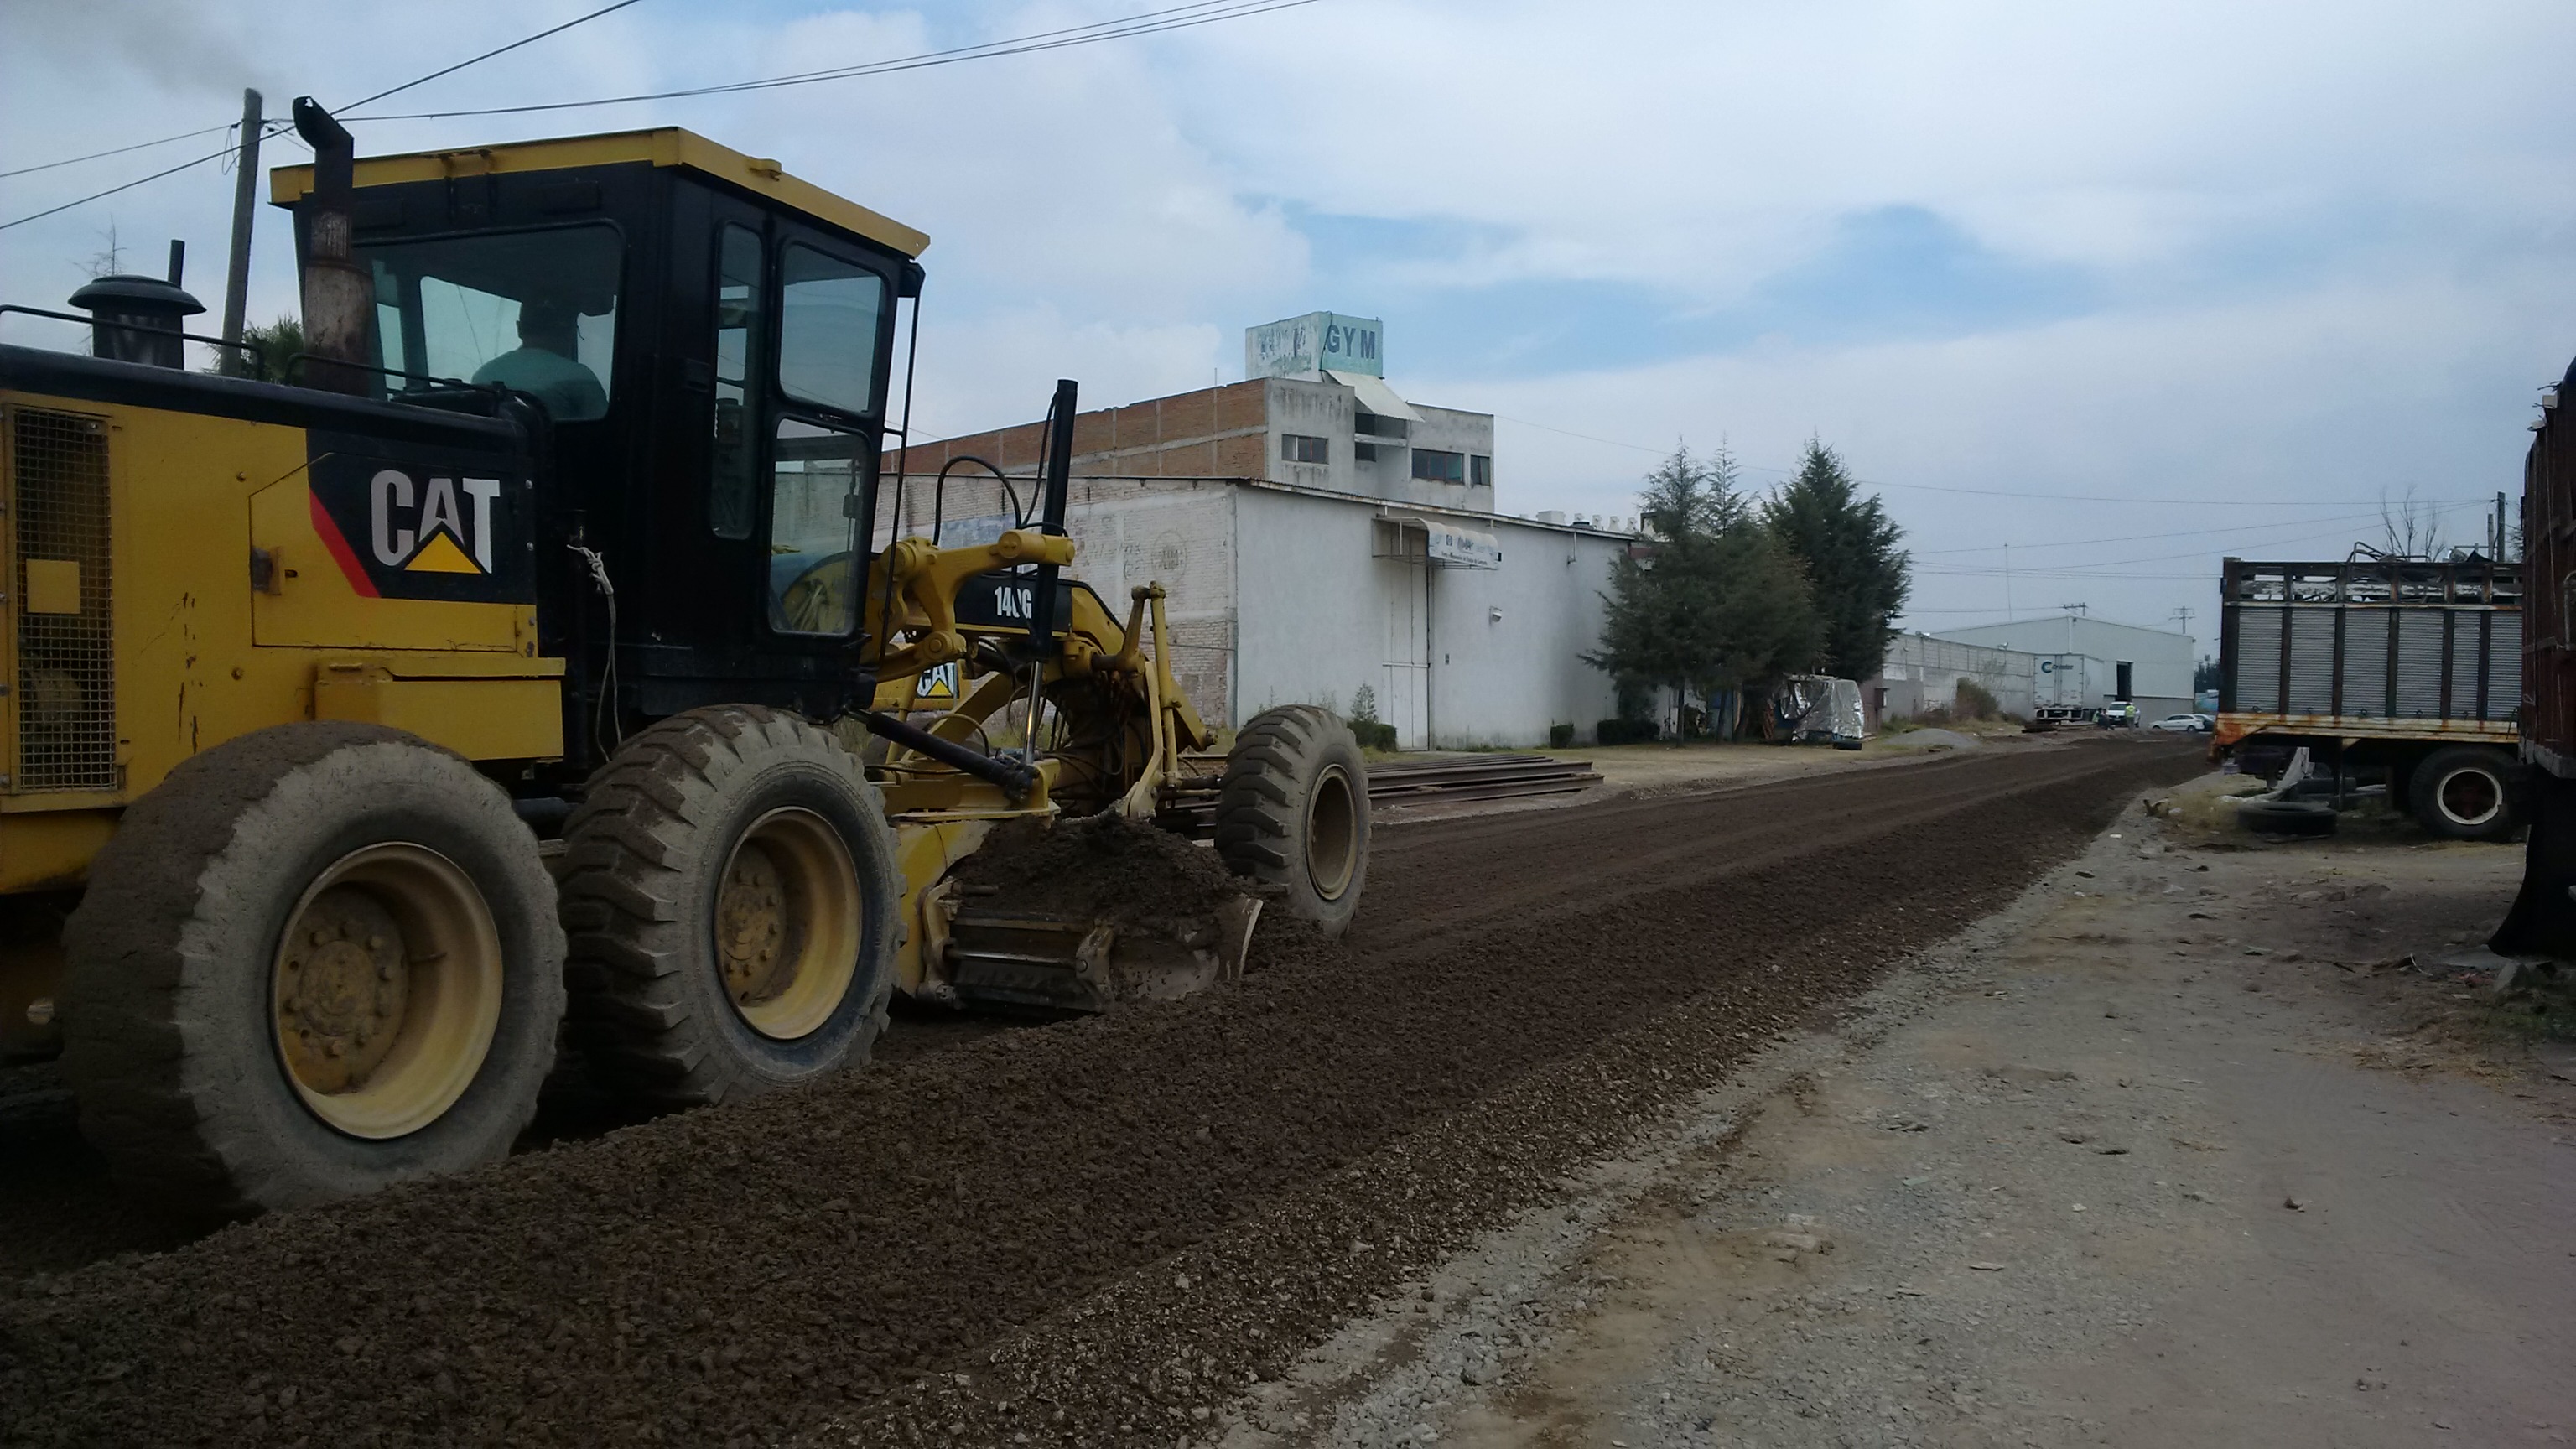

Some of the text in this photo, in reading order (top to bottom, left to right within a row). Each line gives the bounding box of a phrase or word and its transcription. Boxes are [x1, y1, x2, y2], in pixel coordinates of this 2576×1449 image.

[1327, 325, 1374, 359] GYM
[371, 470, 501, 574] CAT
[917, 662, 956, 697] CAT
